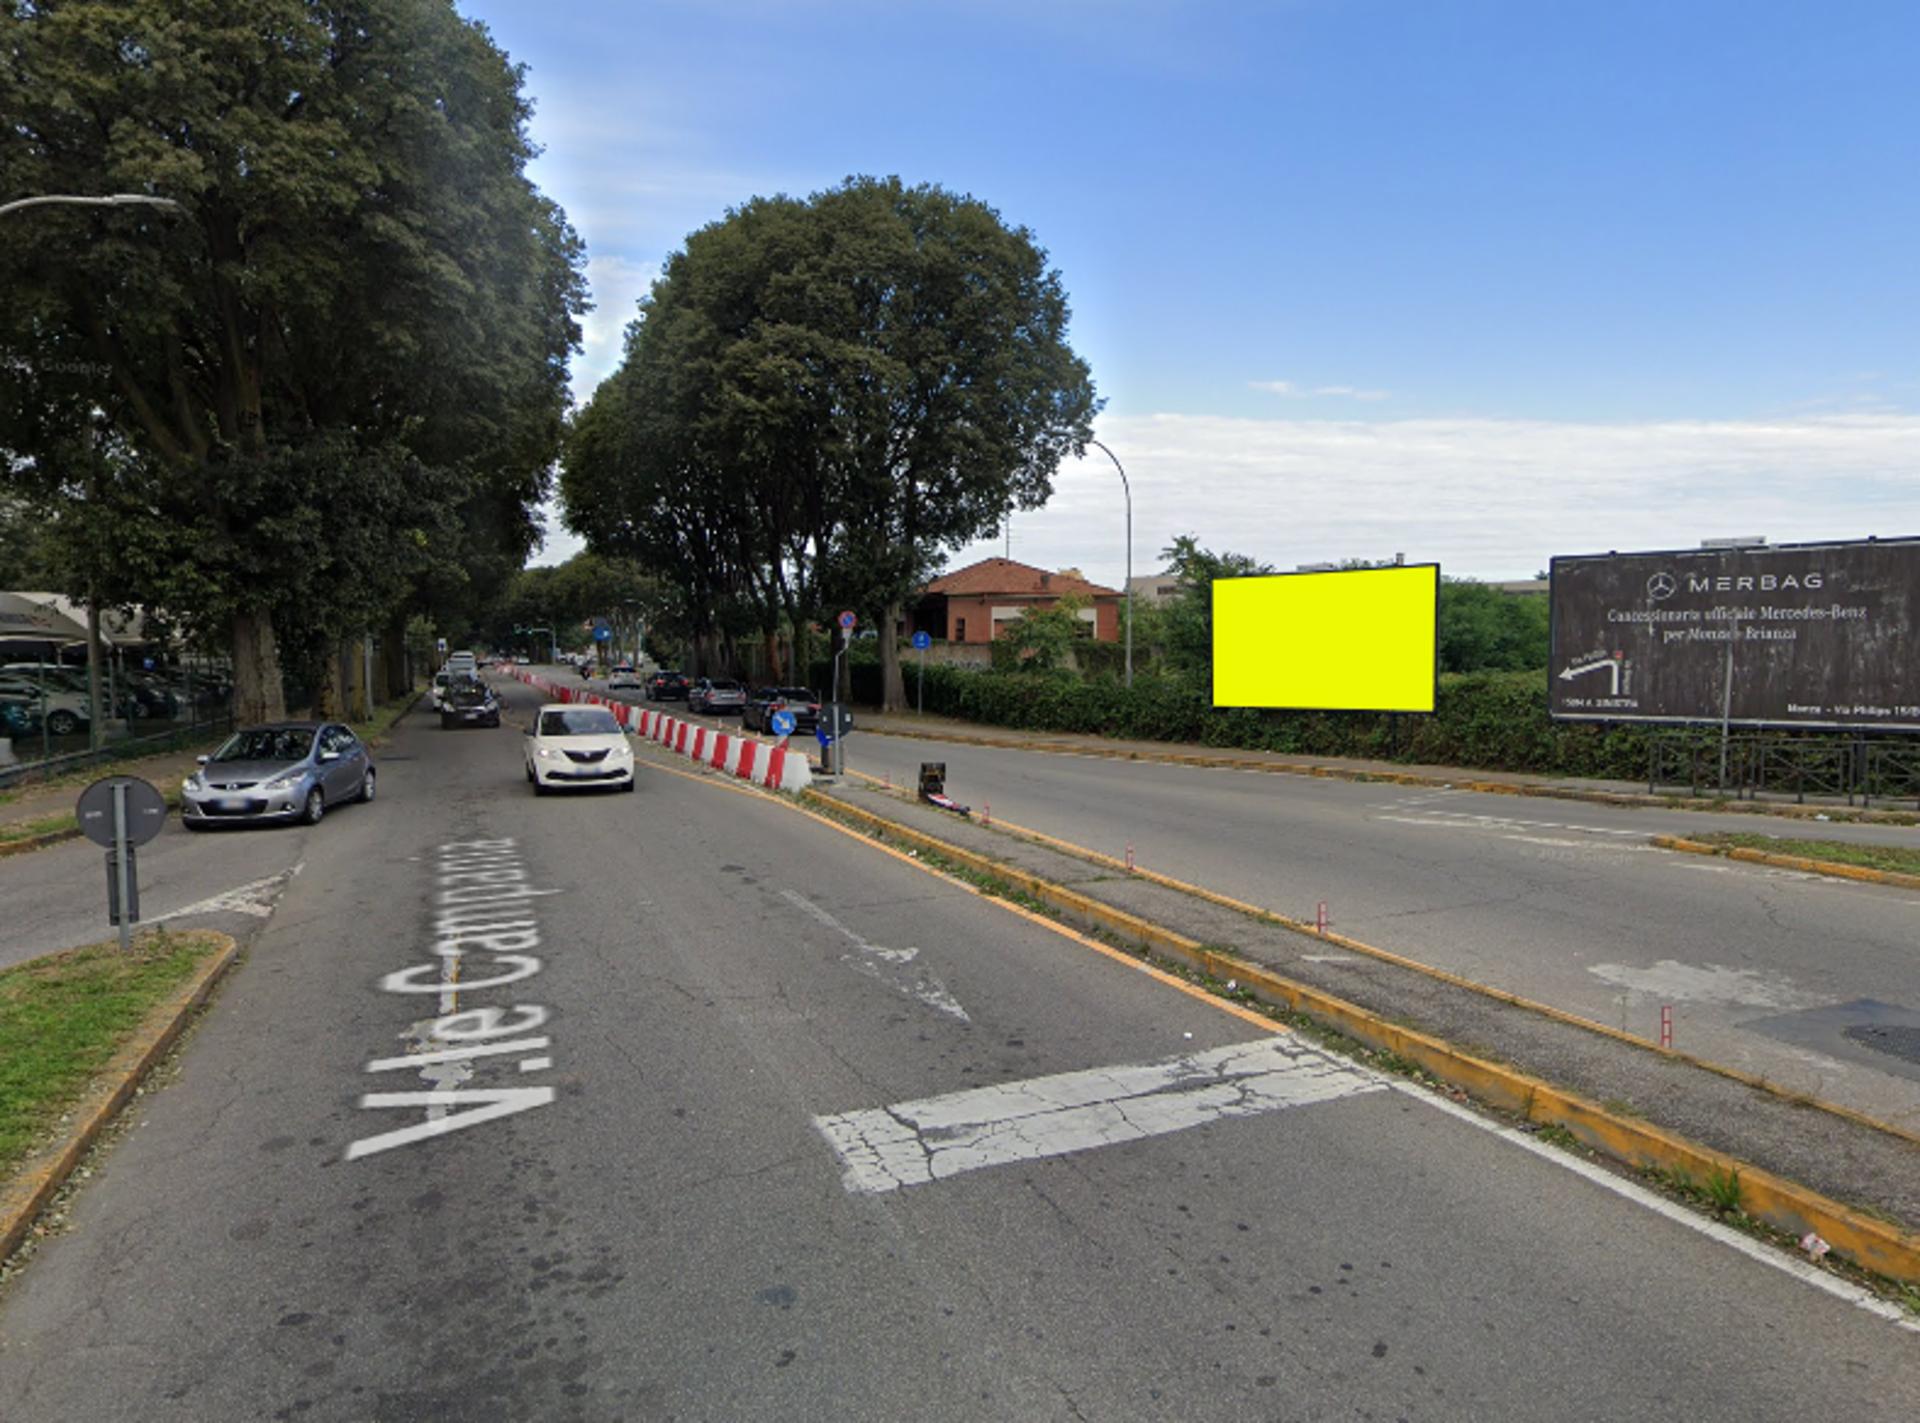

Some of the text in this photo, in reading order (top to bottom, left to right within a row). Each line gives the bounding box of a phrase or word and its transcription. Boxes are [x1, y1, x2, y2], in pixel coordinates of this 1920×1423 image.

[1689, 573, 1824, 593] MERBAG
[1760, 603, 1868, 620] Mercedes-Benz
[1663, 629, 1686, 644] per
[1745, 626, 1798, 640] Brianza
[343, 837, 566, 1161] V.le Campania
